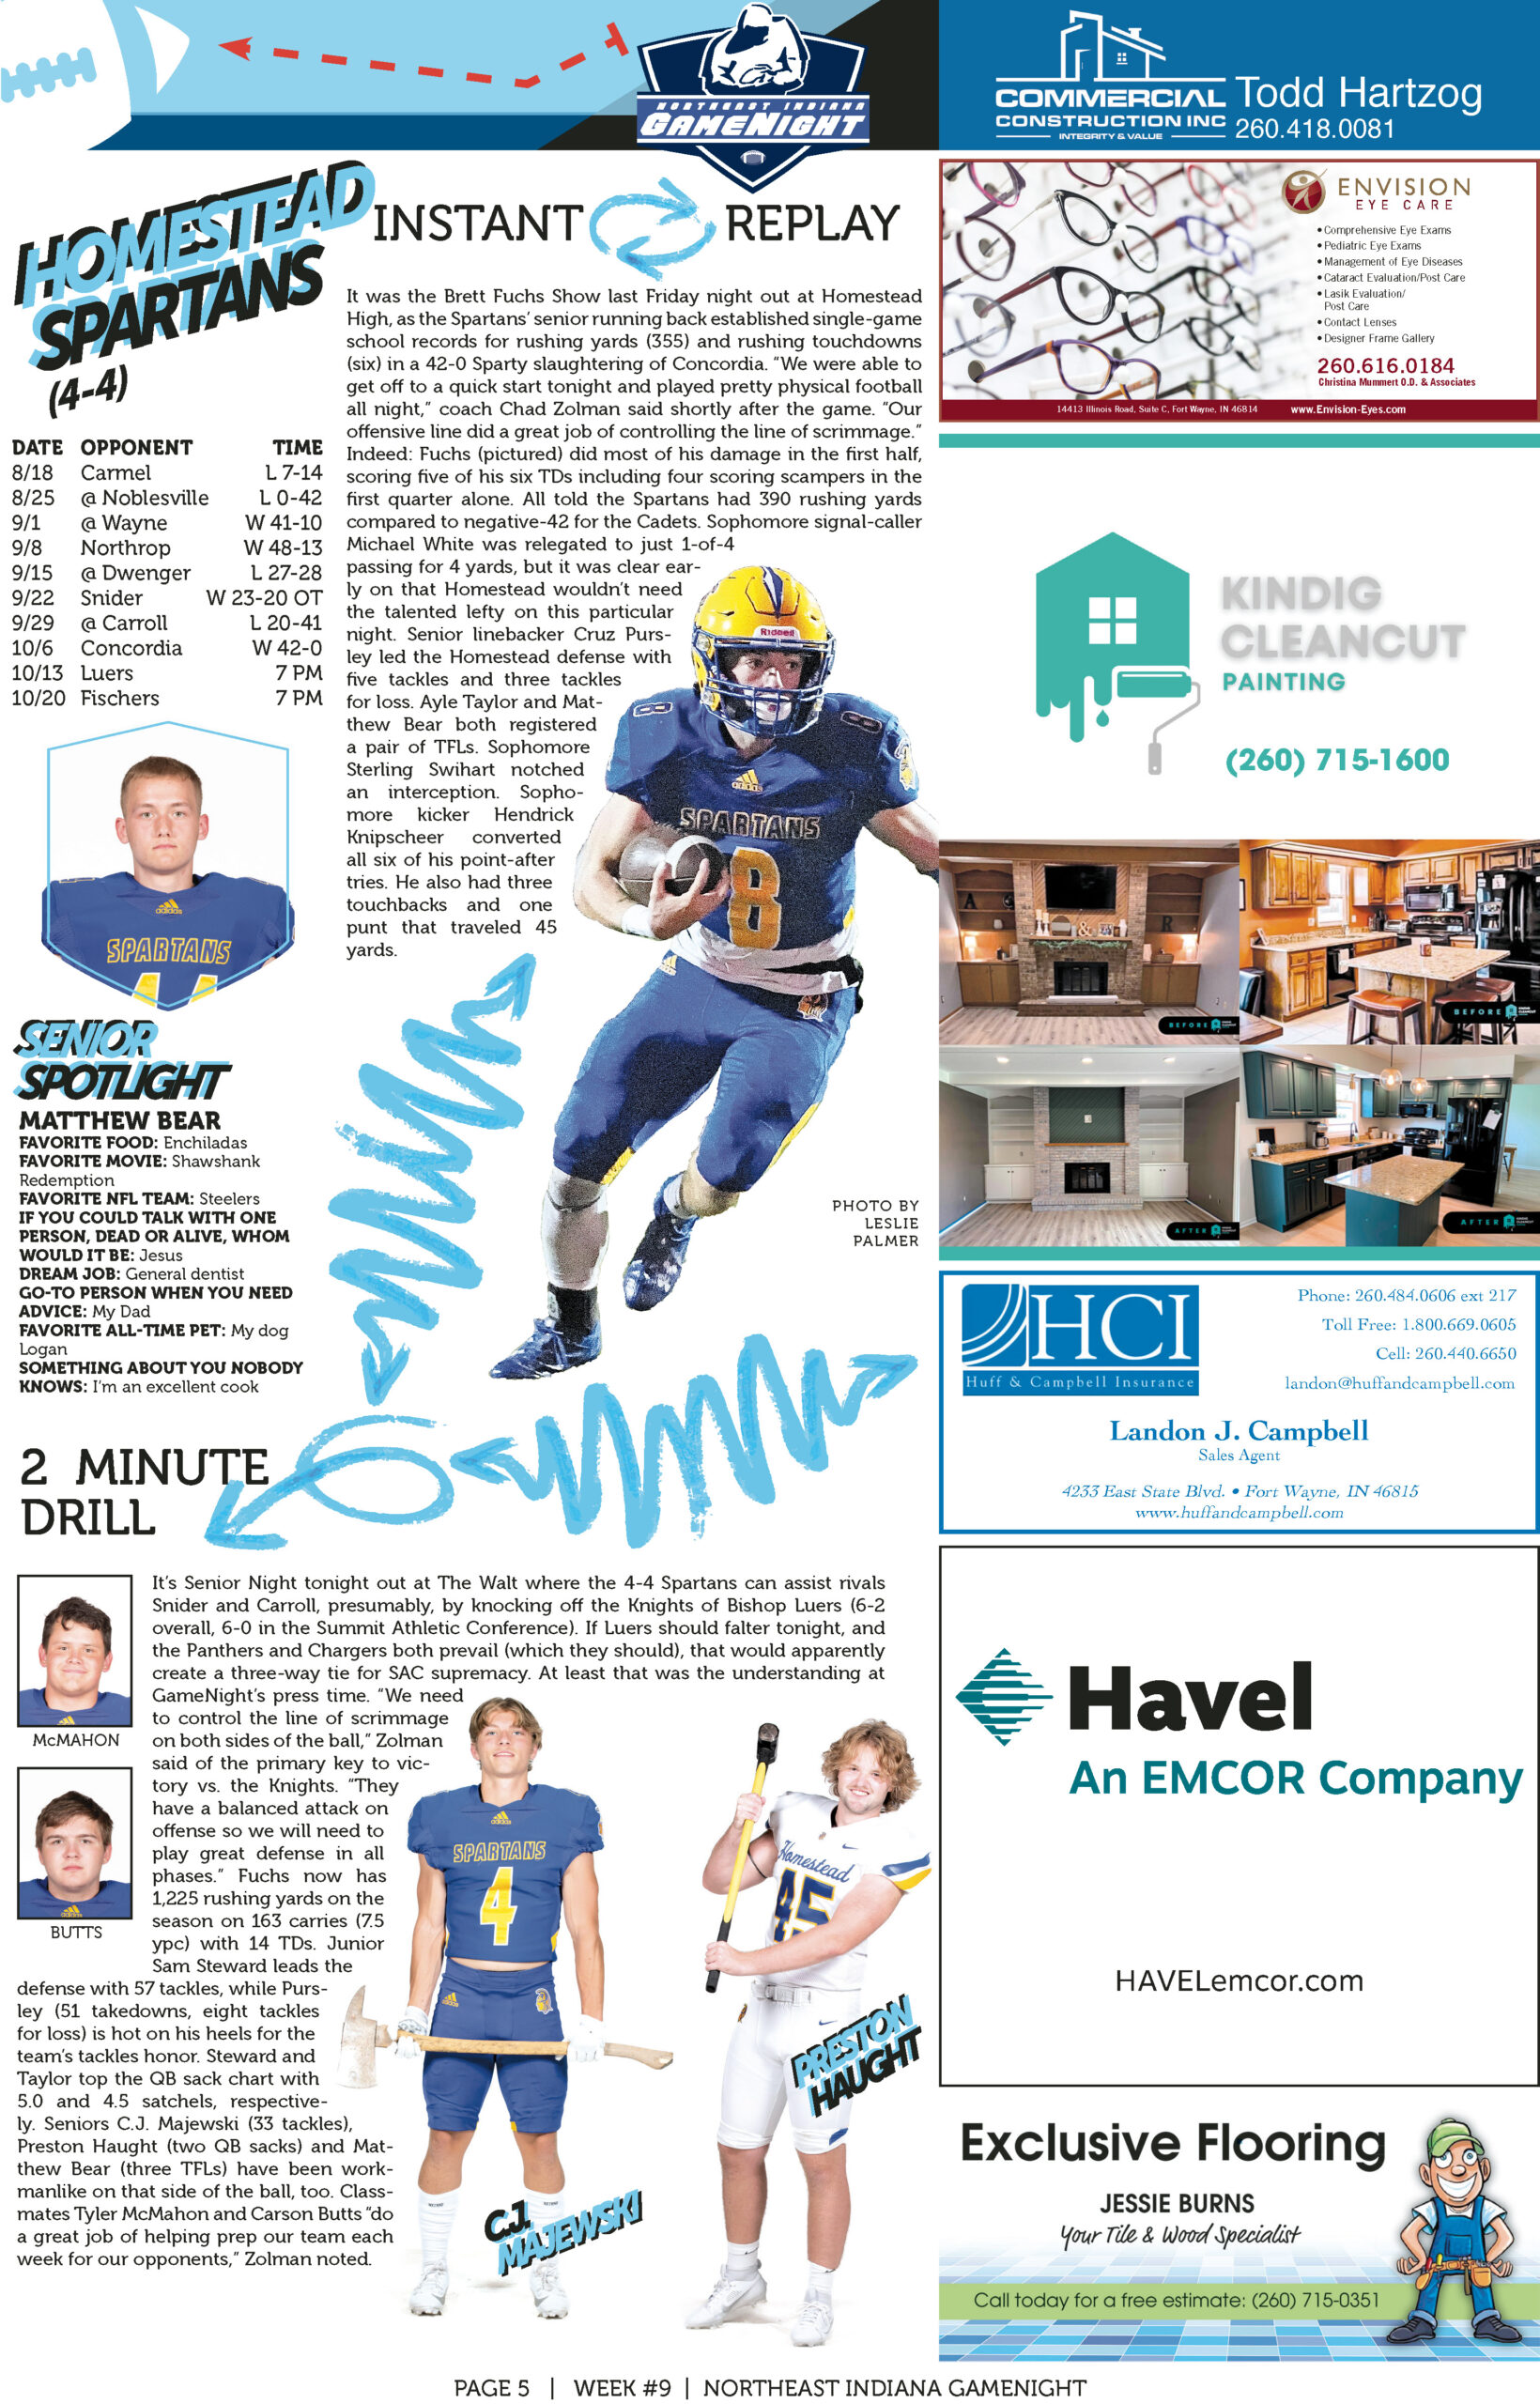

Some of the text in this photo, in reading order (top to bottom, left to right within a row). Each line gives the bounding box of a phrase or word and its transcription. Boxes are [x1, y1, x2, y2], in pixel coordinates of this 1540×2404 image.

[995, 89, 1226, 107] COMMERCIAL
[1236, 76, 1481, 116] Todd Hartzog
[996, 116, 1225, 127] CONSTRUCTION INC
[1236, 118, 1392, 139] 260.418.0081
[1339, 178, 1470, 195] ENVISION
[1357, 200, 1452, 209] EYE CARE
[375, 205, 900, 240] INSTANT REPLAY
[1324, 225, 1451, 236] Comprehensive Eye Exams
[14, 160, 376, 309] HOMESTEAD
[28, 239, 325, 371] SPARTANS
[347, 289, 922, 306] It was the Brett Fuchs Show last Friday night out at Homestead
[1317, 358, 1455, 374] 260.616.0184
[49, 364, 128, 419] (4-4)
[1319, 378, 1356, 386] Christina
[1401, 378, 1417, 386] O.D.
[1430, 378, 1475, 386] Associates
[1190, 406, 1216, 414] Wayne,
[1291, 405, 1406, 415] www.Envision-Eyes.com
[12, 439, 322, 455] DATE OPPONENT TIME
[1224, 577, 1381, 610] KINDIG
[1222, 624, 1466, 658] CLEANCUT
[1224, 672, 1345, 691] PAINTING
[13, 689, 322, 706] 10/20 Fischers 7 PM
[1226, 748, 1449, 778] (260) 715-1600
[680, 808, 821, 839] SPARTANS
[727, 846, 781, 949] 8
[106, 937, 232, 964] SPARTANS
[13, 1020, 158, 1058] SENIOR
[13, 1061, 233, 1100] SPOTLIGHT
[20, 1111, 221, 1130] MATTHEW BEAR
[833, 1200, 918, 1211] PHOTO BY
[866, 1218, 917, 1228] LESLIE
[854, 1236, 917, 1246] PALMER
[1299, 1288, 1517, 1302] Phone: 260.484.0606 ext 217
[1031, 1294, 1192, 1360] HCI
[967, 1376, 1193, 1390] Huff & Campbell Insurance
[1286, 1376, 1514, 1393] landon@huffandcampbell.com
[1110, 1419, 1368, 1447] Landon J. Campbell
[22, 1448, 269, 1486] 2 MINUTE
[1062, 1484, 1419, 1501] 4233 East State Blvd. Fort Wayne, IN 46815
[22, 1499, 155, 1534] DRILL
[1136, 1505, 1343, 1522] www.huffandcampbell.com
[1070, 1661, 1311, 1731] Havel
[33, 1734, 119, 1746] McMAHON
[1070, 1760, 1524, 1804] An EMCOR Company
[453, 1841, 547, 1863] SPARTANS
[778, 1840, 855, 1883] Homestead
[480, 1866, 518, 1947] 4
[774, 1867, 836, 1943] 45
[52, 1926, 101, 1938] BUTTS
[1117, 1970, 1363, 1992] HAVELemcor.com
[791, 1994, 914, 2089] PRESTON
[807, 2025, 922, 2119] HAUGHT
[19, 2094, 327, 2111] 5.0 and 4.5 satchels, respective-
[962, 2123, 1385, 2172] Exclusive Flooring
[1101, 2194, 1255, 2213] JESSIE BURNS
[485, 2199, 534, 2242] C.J.
[499, 2189, 643, 2276] MAJEWSKI
[1061, 2223, 1301, 2251] Your Tile & Wood Specialist
[975, 2292, 1378, 2311] Call today for a free estimate: (260) 715-0351
[454, 2380, 1087, 2396] PAGE 5 WEEK #9 NORTHEAST INDIANA GAMENIGHT
